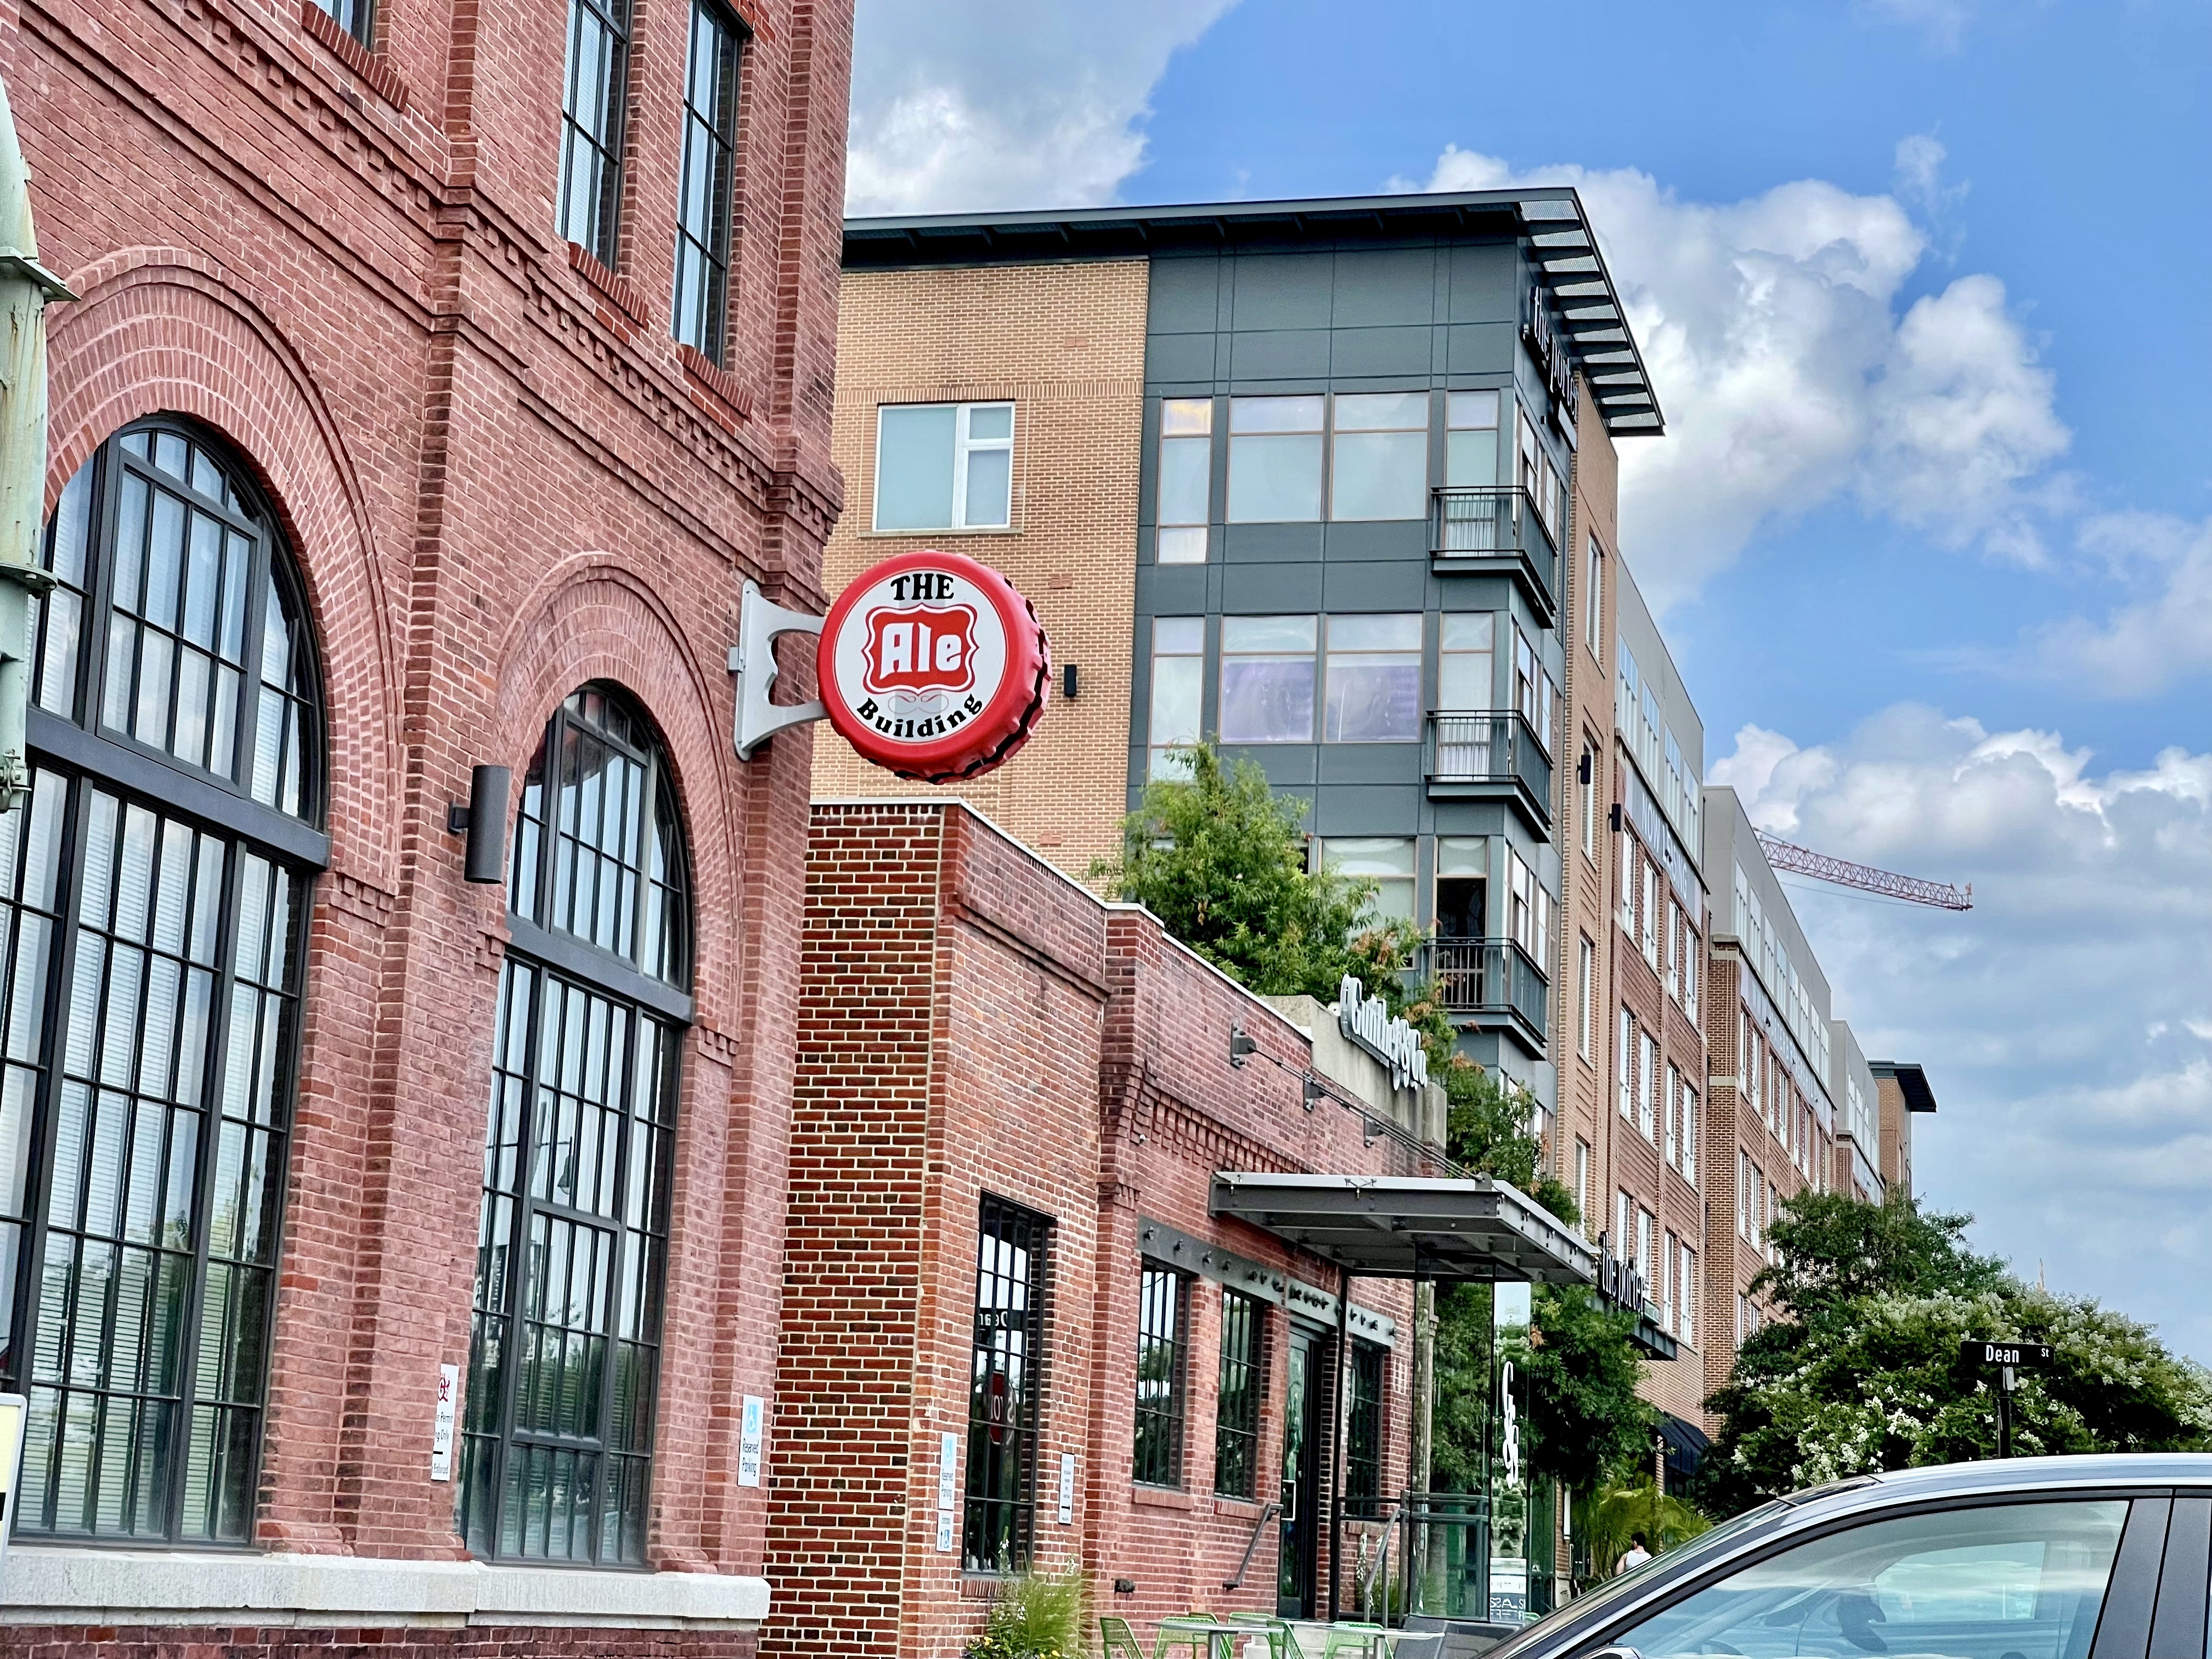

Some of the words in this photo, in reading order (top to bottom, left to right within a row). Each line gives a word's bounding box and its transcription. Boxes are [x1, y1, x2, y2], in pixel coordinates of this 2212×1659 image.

[1534, 286, 1549, 361] the
[890, 573, 954, 600] THE
[880, 622, 962, 680] Ale
[856, 693, 983, 738] Building
[1641, 792, 1661, 853] NOW
[1662, 823, 1687, 900] LEASING
[1985, 1345, 2019, 1363] Dean
[2041, 1348, 2050, 1357] St
[441, 1429, 449, 1443] Only
[742, 1438, 760, 1454] Reserved
[742, 1457, 757, 1477] Parking
